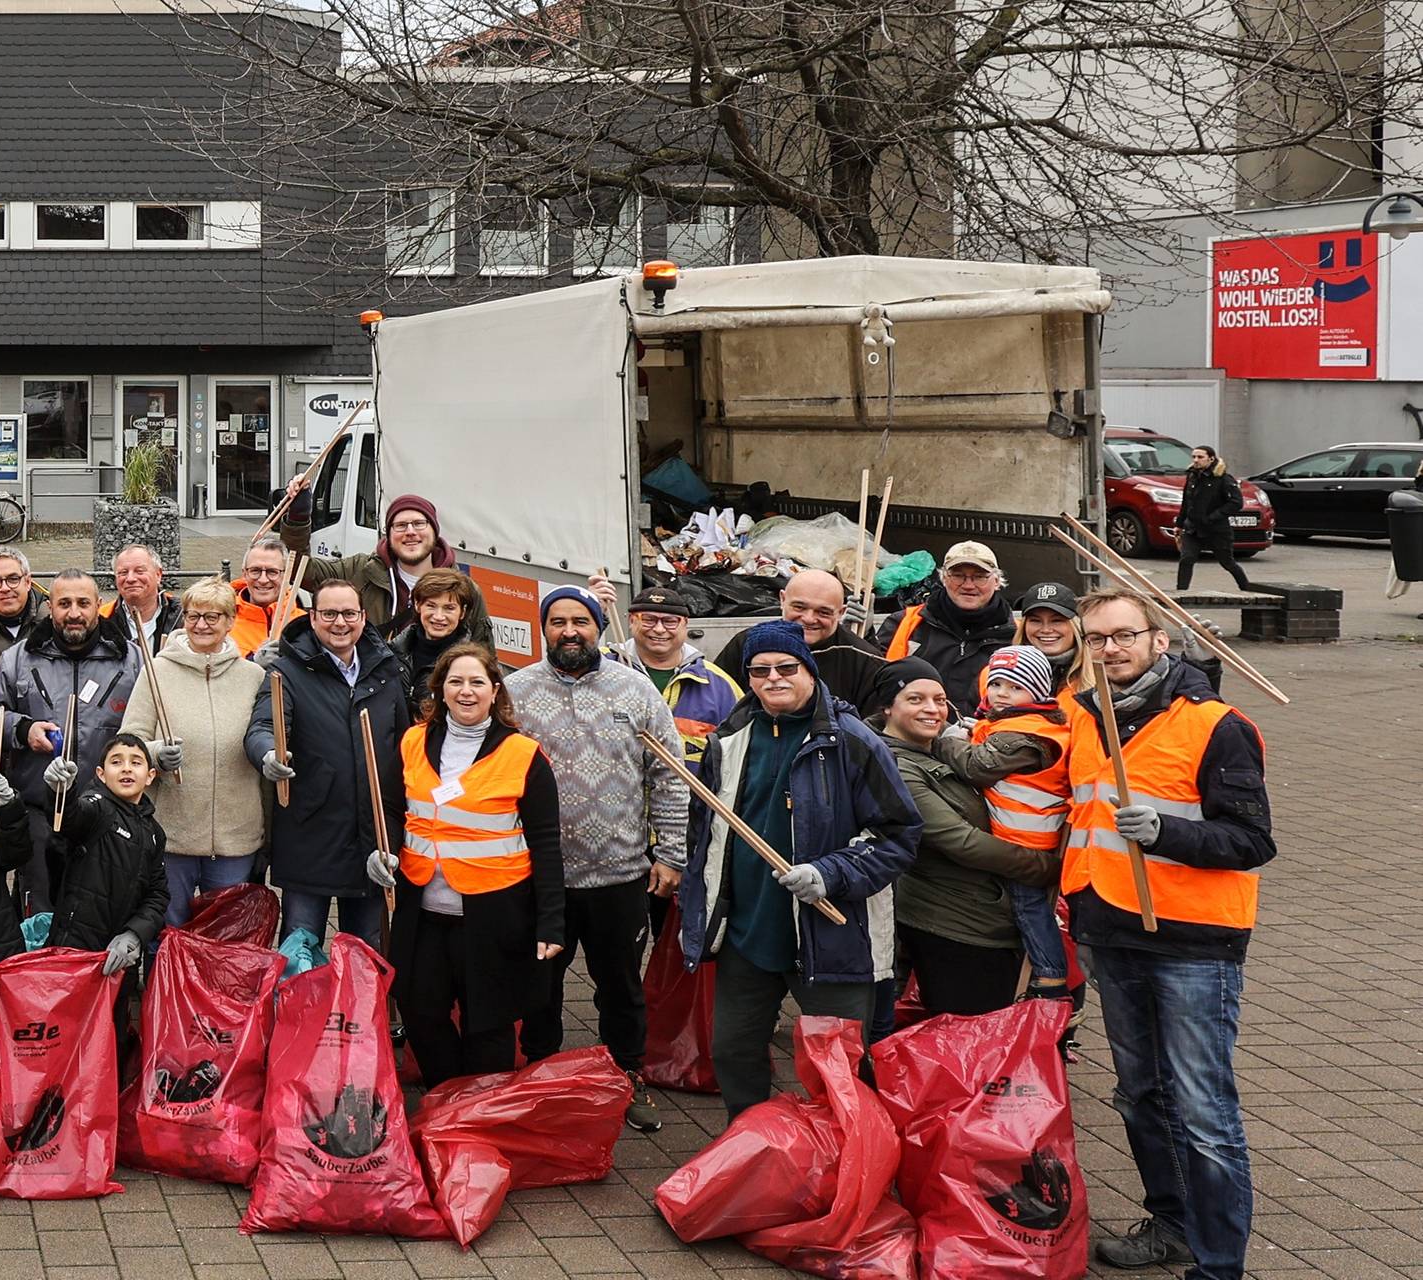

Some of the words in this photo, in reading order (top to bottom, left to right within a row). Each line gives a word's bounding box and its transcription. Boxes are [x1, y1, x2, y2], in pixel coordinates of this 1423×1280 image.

[1218, 269, 1250, 288] WAS
[1252, 267, 1279, 286] DAS
[1218, 290, 1259, 308] WOHL
[1261, 287, 1314, 306] WIEDER
[1218, 308, 1318, 328] KOSTEN...LOS?!
[13, 1022, 61, 1042] e3e
[303, 1147, 389, 1175] SauberZauber
